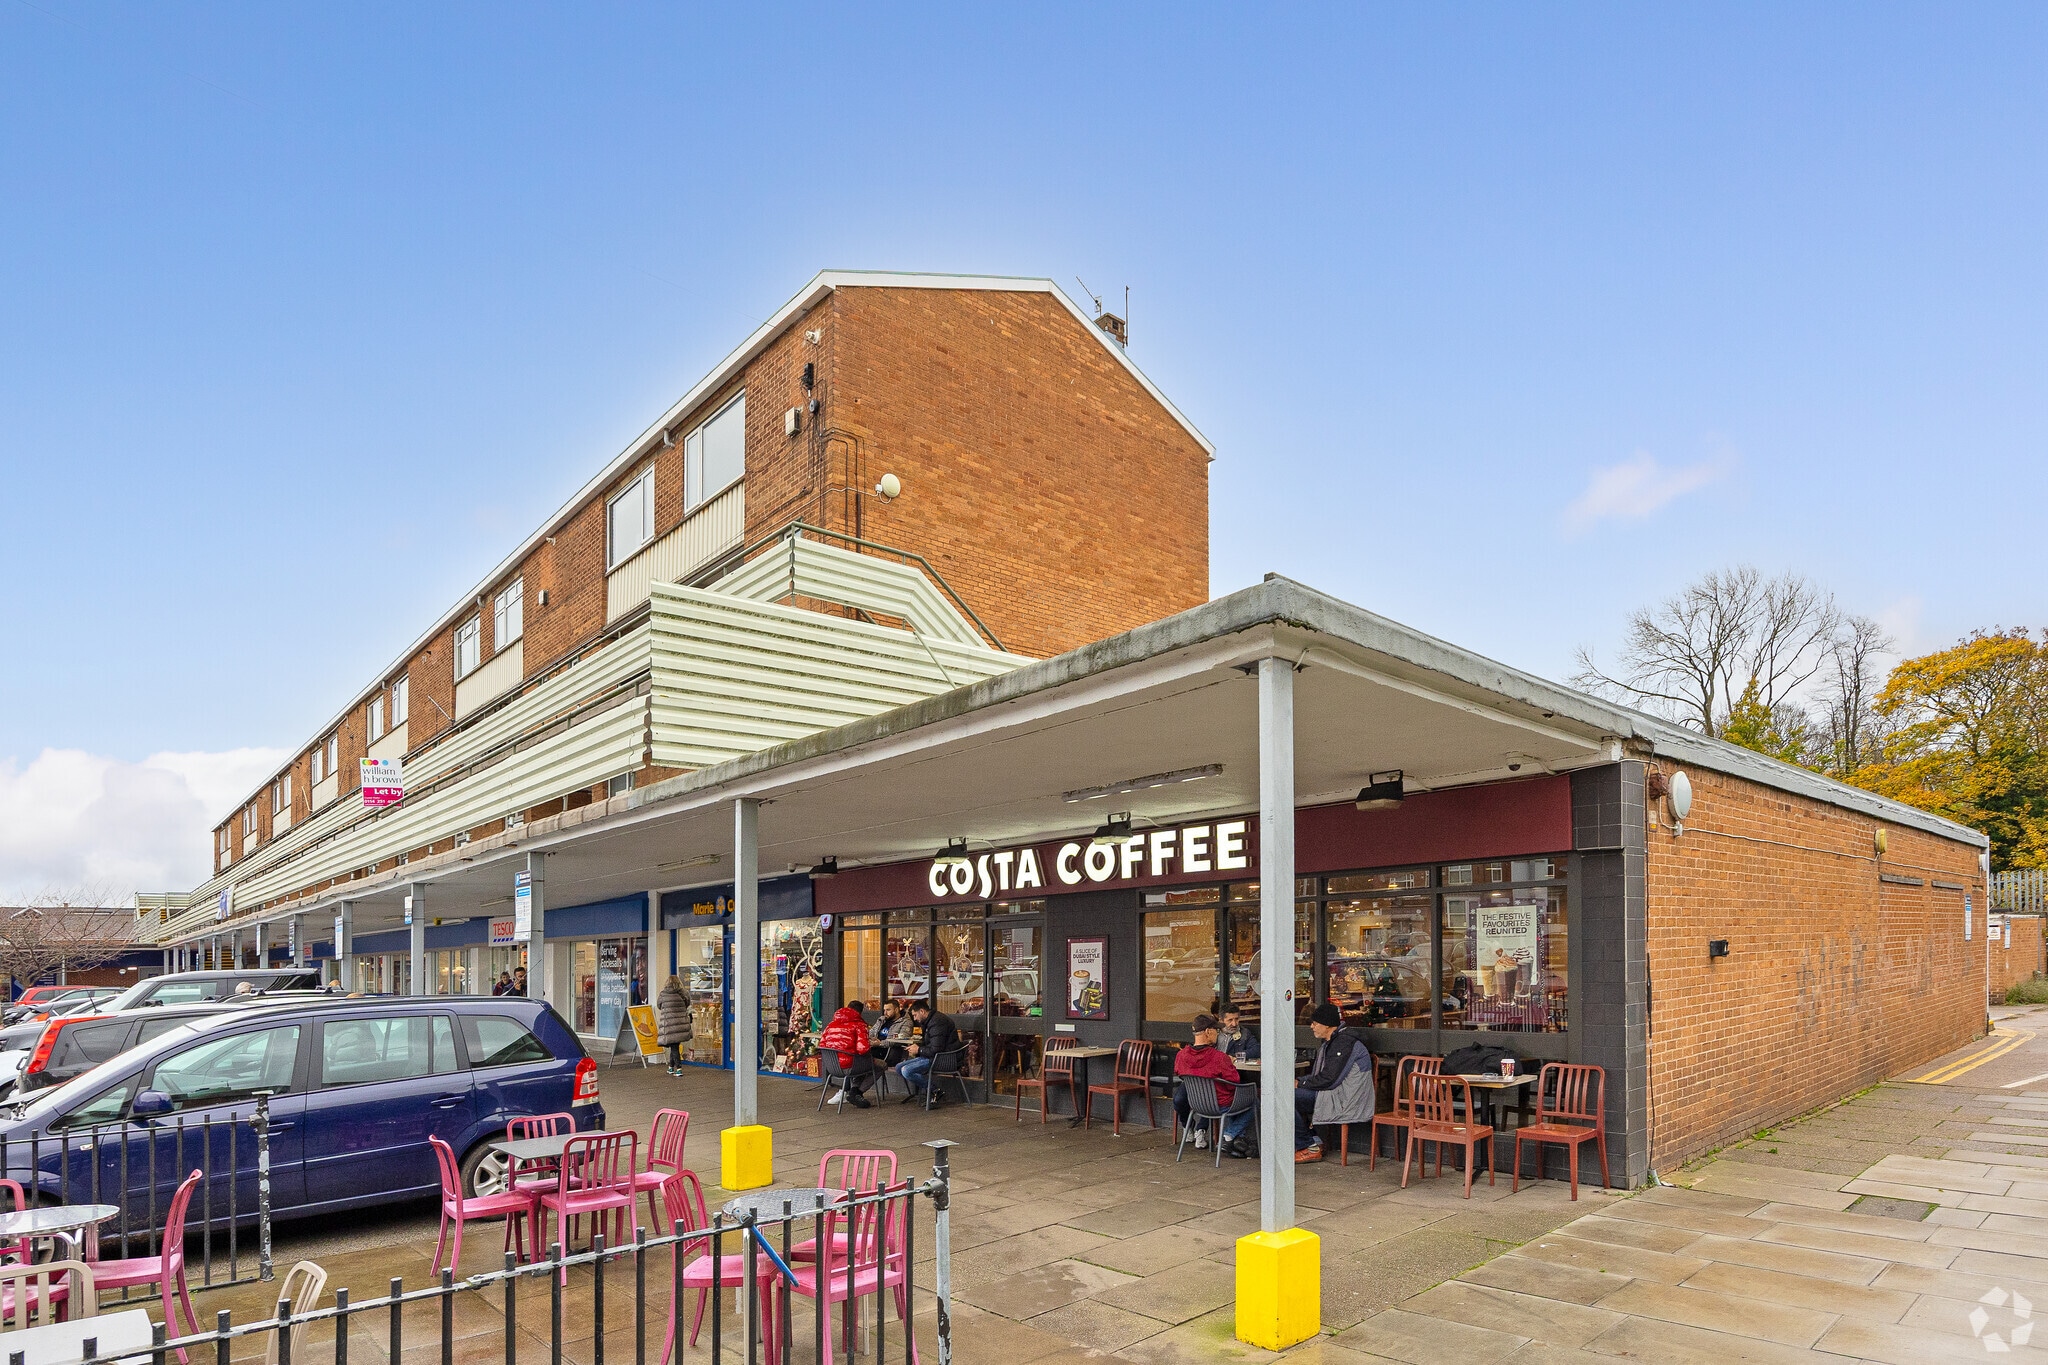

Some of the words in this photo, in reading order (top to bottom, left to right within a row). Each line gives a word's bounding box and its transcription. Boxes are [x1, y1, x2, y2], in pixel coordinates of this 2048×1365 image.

[362, 767, 396, 775] william
[928, 848, 1041, 899] COSTA
[1055, 820, 1247, 886] COFFEE
[693, 901, 715, 915] Marie
[493, 921, 514, 936] TESCO
[1482, 920, 1530, 928] FAVOURITES
[600, 946, 618, 958] Serving
[600, 971, 621, 982] shoppers
[600, 983, 610, 993] little
[600, 997, 613, 1007] every
[613, 996, 622, 1007] day
